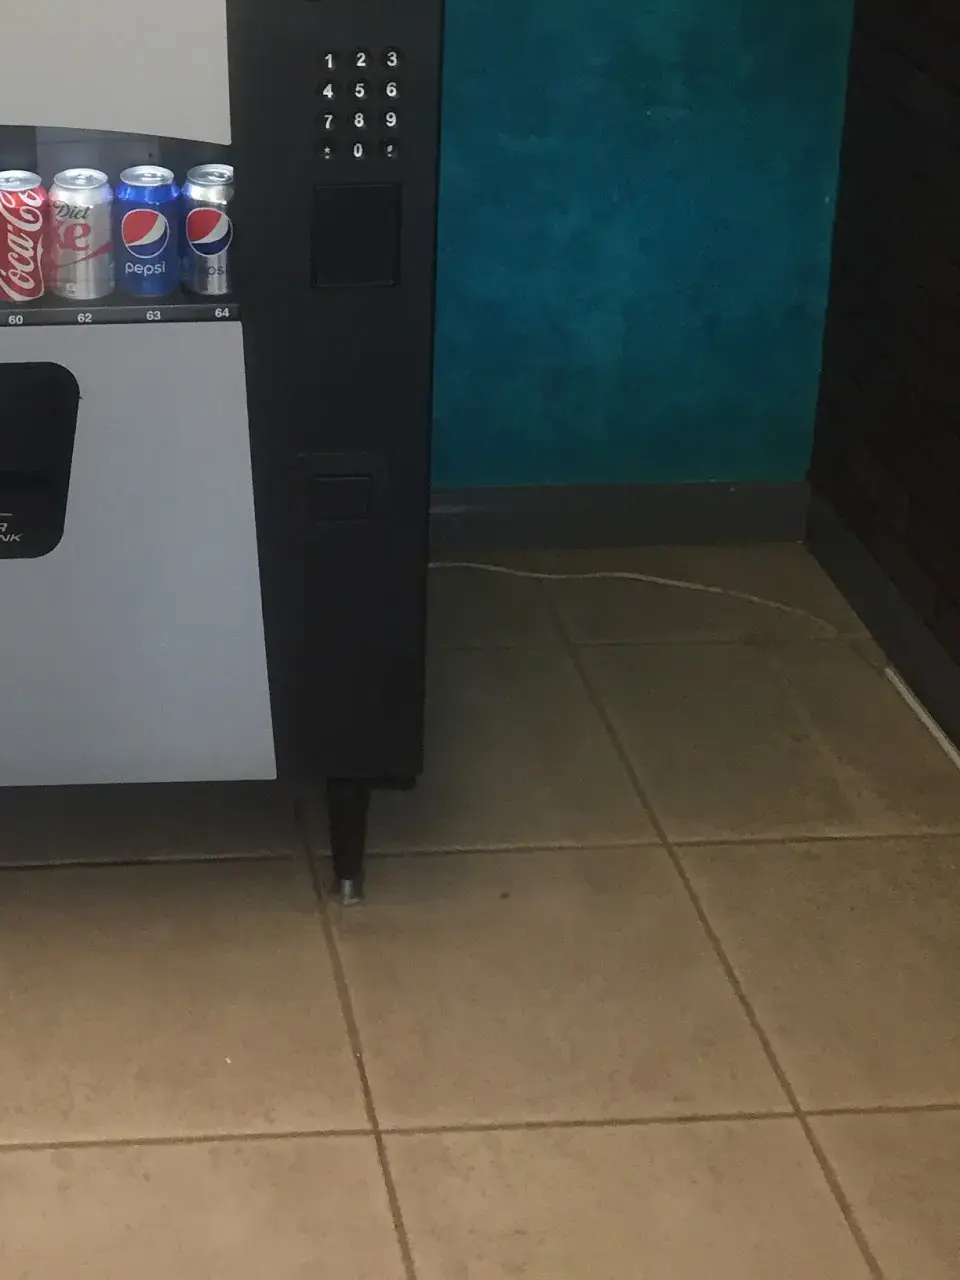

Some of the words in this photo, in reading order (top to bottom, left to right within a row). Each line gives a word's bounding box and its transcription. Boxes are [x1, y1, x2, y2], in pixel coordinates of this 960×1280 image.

[325, 53, 333, 69] 1
[356, 52, 366, 67] 2
[387, 51, 397, 66] 3
[323, 83, 333, 98] 4
[354, 83, 365, 97] 5
[386, 82, 397, 97] 6
[324, 114, 333, 129] 7
[354, 112, 364, 127] 8
[385, 112, 397, 127] 9
[353, 143, 363, 158] 0
[53, 200, 91, 219] Diet
[125, 261, 166, 277] pepsi
[8, 315, 24, 325] 60
[77, 313, 92, 323] 62
[146, 311, 161, 320] 63
[215, 308, 230, 318] 64
